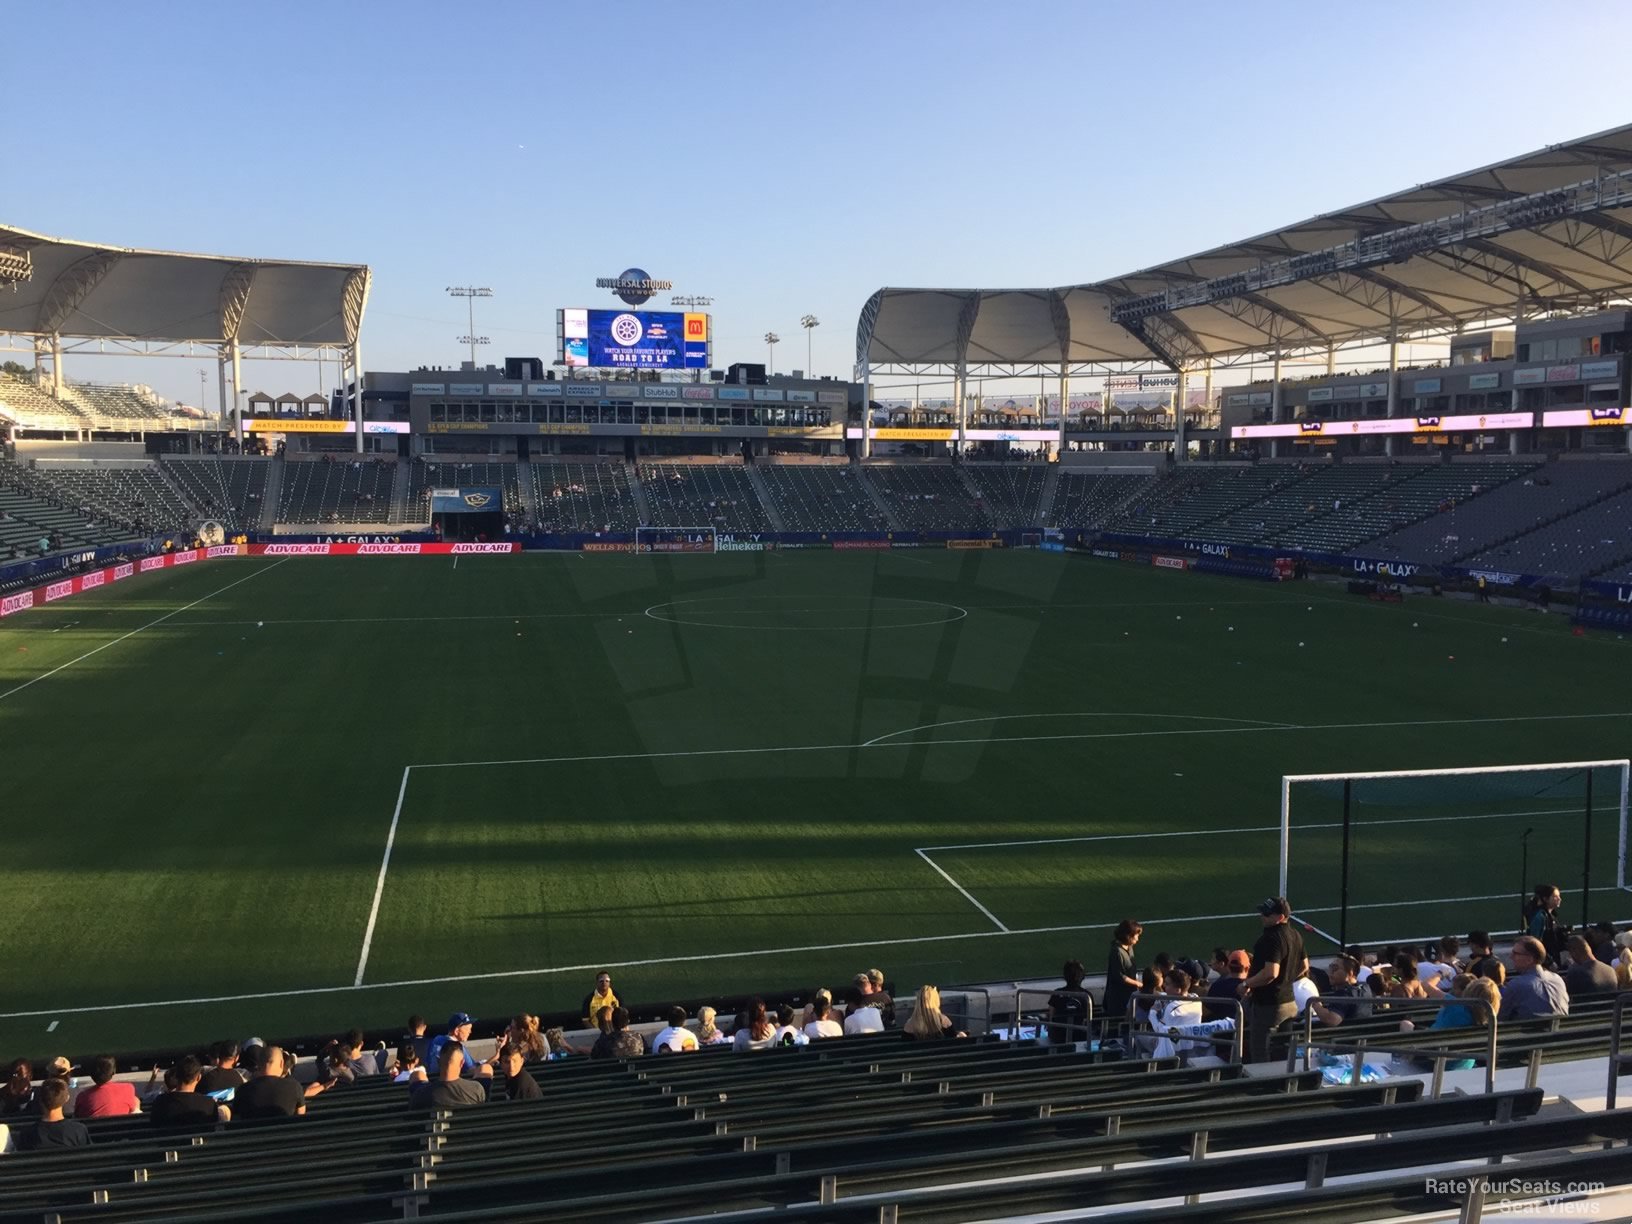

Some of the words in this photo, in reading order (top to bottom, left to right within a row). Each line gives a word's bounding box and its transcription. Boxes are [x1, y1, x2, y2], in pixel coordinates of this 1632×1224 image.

[596, 277, 641, 289] UNIVERSAL
[642, 279, 673, 290] STUDIOS
[612, 354, 637, 362] ROAD
[656, 355, 668, 363] LA
[646, 388, 676, 398] StubHub
[1068, 400, 1099, 410] OYOTA
[265, 544, 329, 553] ADVOCARE
[360, 544, 420, 553] ADVOCARE
[454, 544, 511, 552] ADVOCARE
[716, 541, 763, 551] Heineken
[1157, 558, 1182, 568] ADVOCARE
[1354, 559, 1367, 572] LA
[46, 582, 72, 600] ADVOCARE
[2, 593, 33, 613] ADVOCARE
